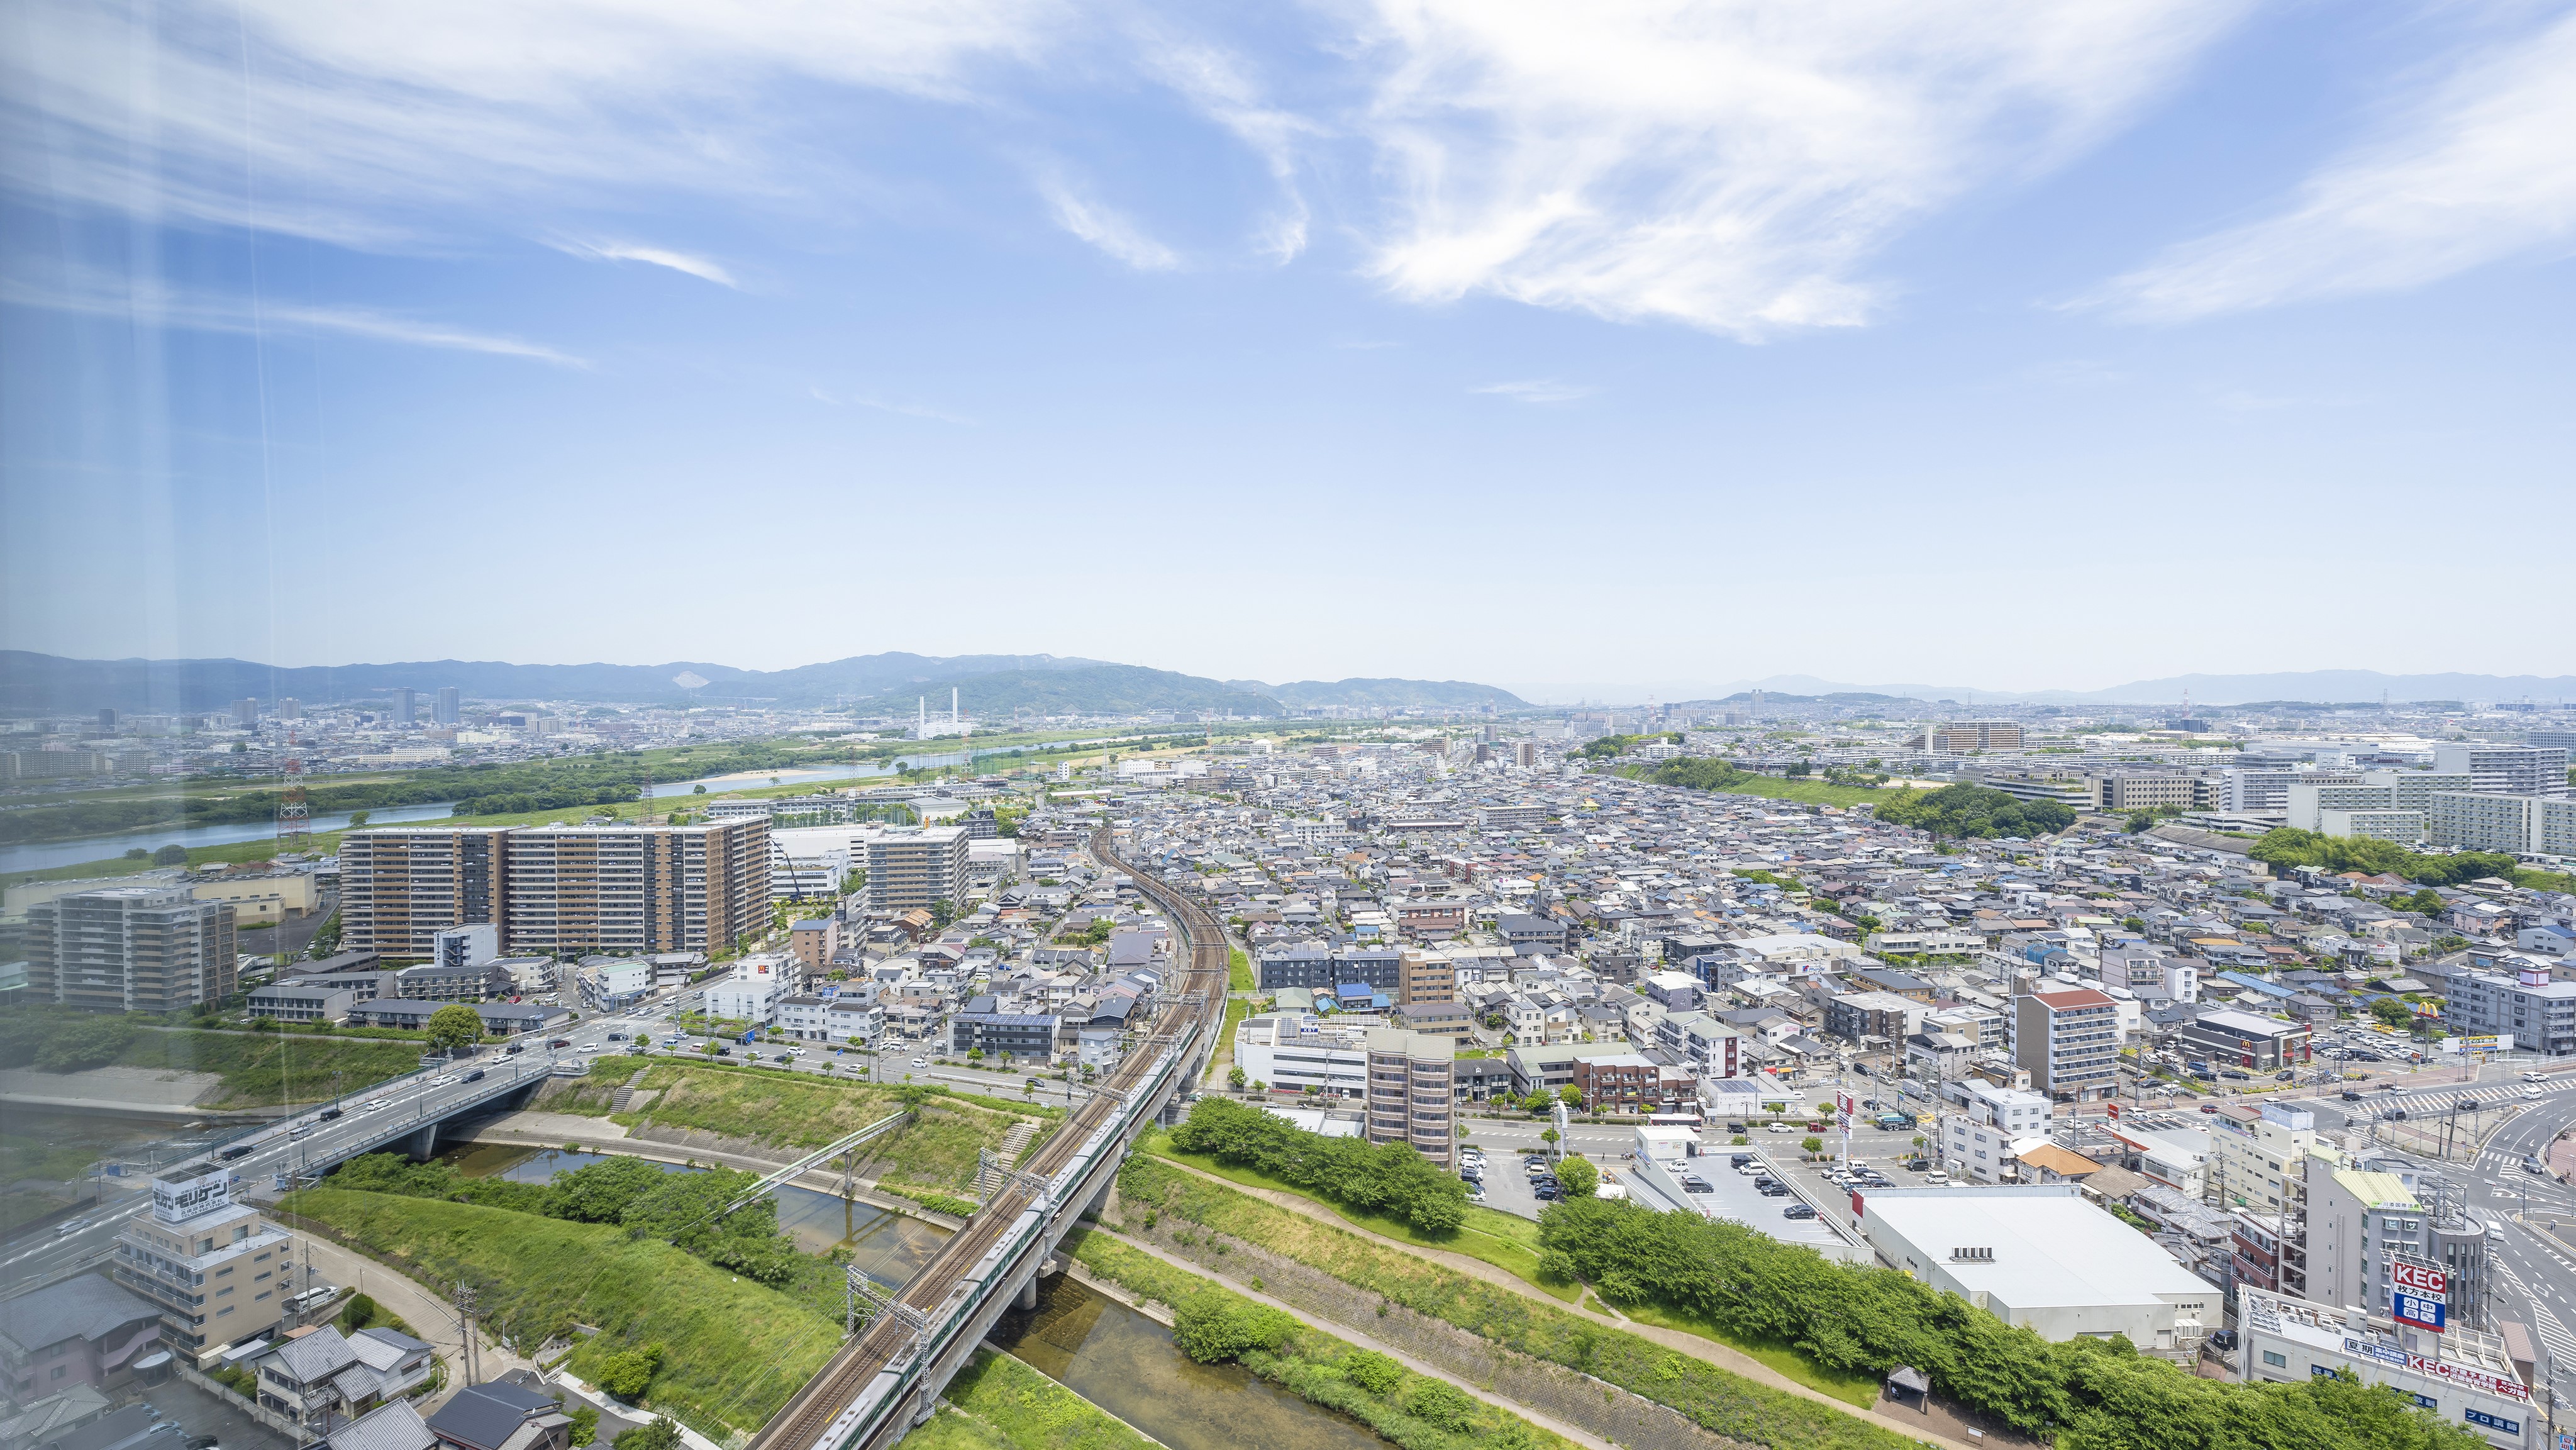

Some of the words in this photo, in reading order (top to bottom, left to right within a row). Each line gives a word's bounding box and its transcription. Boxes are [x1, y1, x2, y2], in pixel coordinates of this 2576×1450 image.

[2097, 1126, 2113, 1137] ENEOS
[153, 1190, 174, 1210] モリケン
[175, 1182, 227, 1208] モリケン
[2397, 1265, 2443, 1290] KEC
[2397, 1285, 2443, 1302] 枚方本校
[2406, 1308, 2416, 1317] 高
[2348, 1340, 2373, 1354] 夏期
[2410, 1356, 2449, 1376] KEC
[2467, 1410, 2518, 1431] プロ講師
